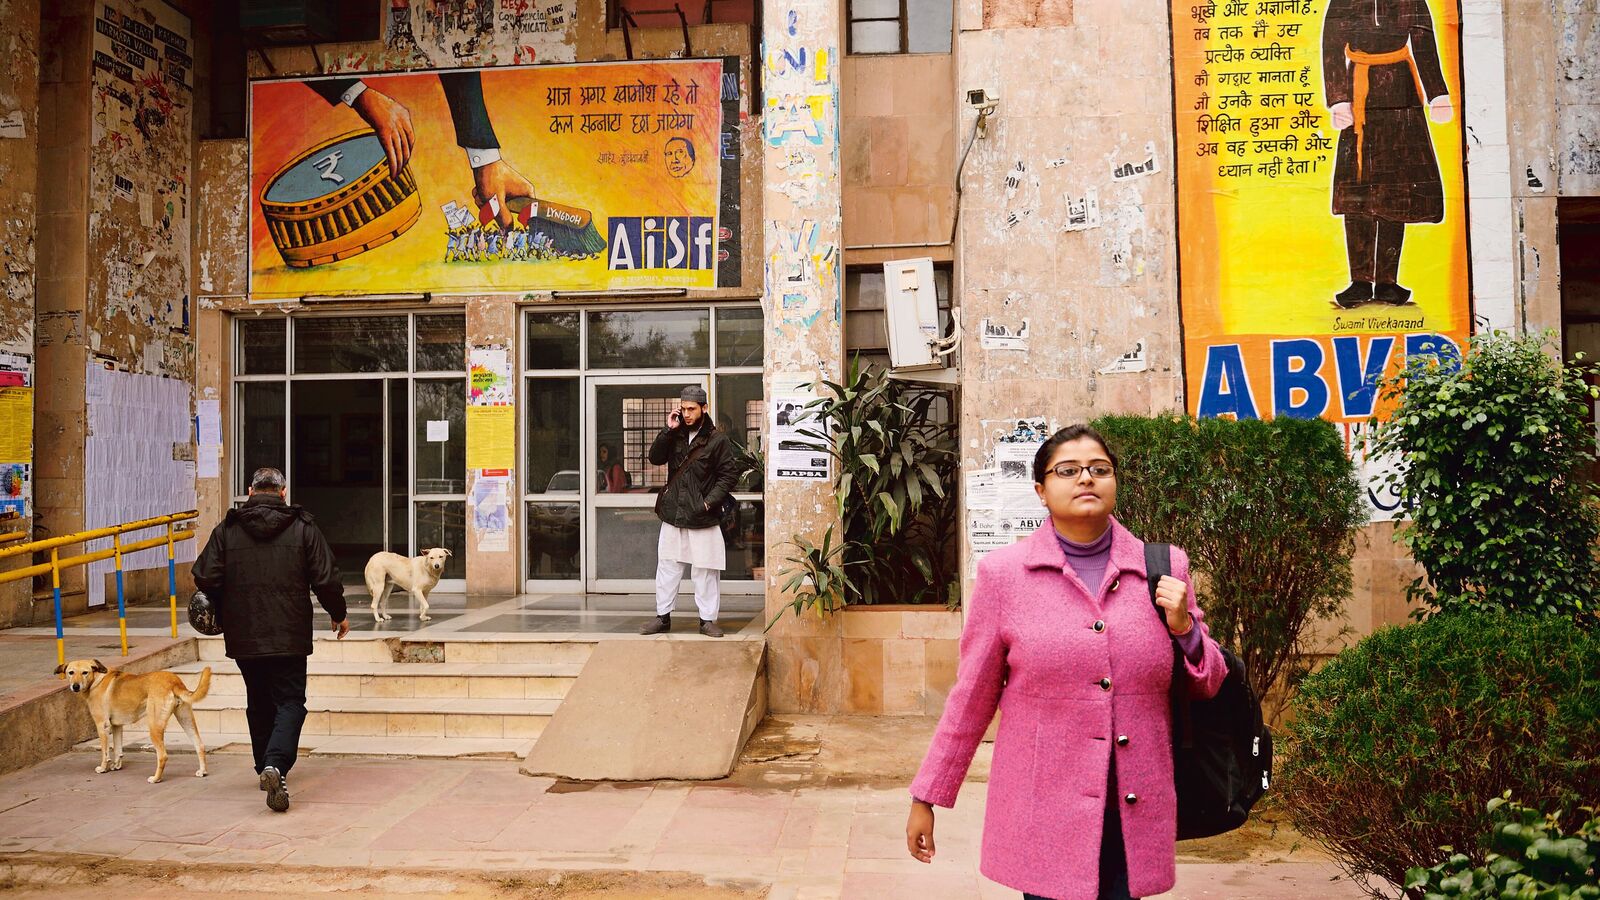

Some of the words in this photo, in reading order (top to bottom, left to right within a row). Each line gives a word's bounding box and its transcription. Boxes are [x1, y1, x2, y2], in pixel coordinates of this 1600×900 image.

[547, 4, 563, 15] 2013
[1193, 28, 1211, 41] तब
[1218, 26, 1243, 40] तक
[1251, 19, 1269, 38] मैं
[1277, 24, 1302, 38] उस
[134, 40, 156, 60] VALLEY
[1205, 44, 1245, 64] प्रत्येक
[1250, 42, 1295, 61] व्यक्ति
[1194, 70, 1210, 87] को
[1257, 71, 1296, 83] मानता
[1299, 66, 1311, 88] हूँ
[546, 87, 571, 106] आज
[580, 86, 606, 106] अगर
[663, 78, 681, 105] रहे
[685, 78, 699, 106] तो
[1194, 92, 1211, 111] जो
[1218, 90, 1252, 109] उनके
[1260, 94, 1288, 108] बल
[1293, 92, 1314, 107] पर
[549, 114, 574, 134] कल
[630, 114, 651, 134] छा
[651, 108, 695, 134] जायेगा
[1196, 113, 1242, 135] शिक्षित
[1250, 116, 1284, 137] हुआ
[1290, 110, 1322, 129] और
[1196, 142, 1219, 157] अब
[1226, 141, 1248, 157] वह
[1253, 134, 1299, 154] उसकी
[1305, 133, 1333, 151] ओर
[1218, 164, 1253, 177] ध्यान
[1257, 156, 1283, 178] नहीं
[546, 206, 582, 225] LYNGDOH
[1333, 317, 1365, 331] Swami
[1368, 317, 1424, 330] Vivekanand
[1020, 519, 1046, 528] ABV
